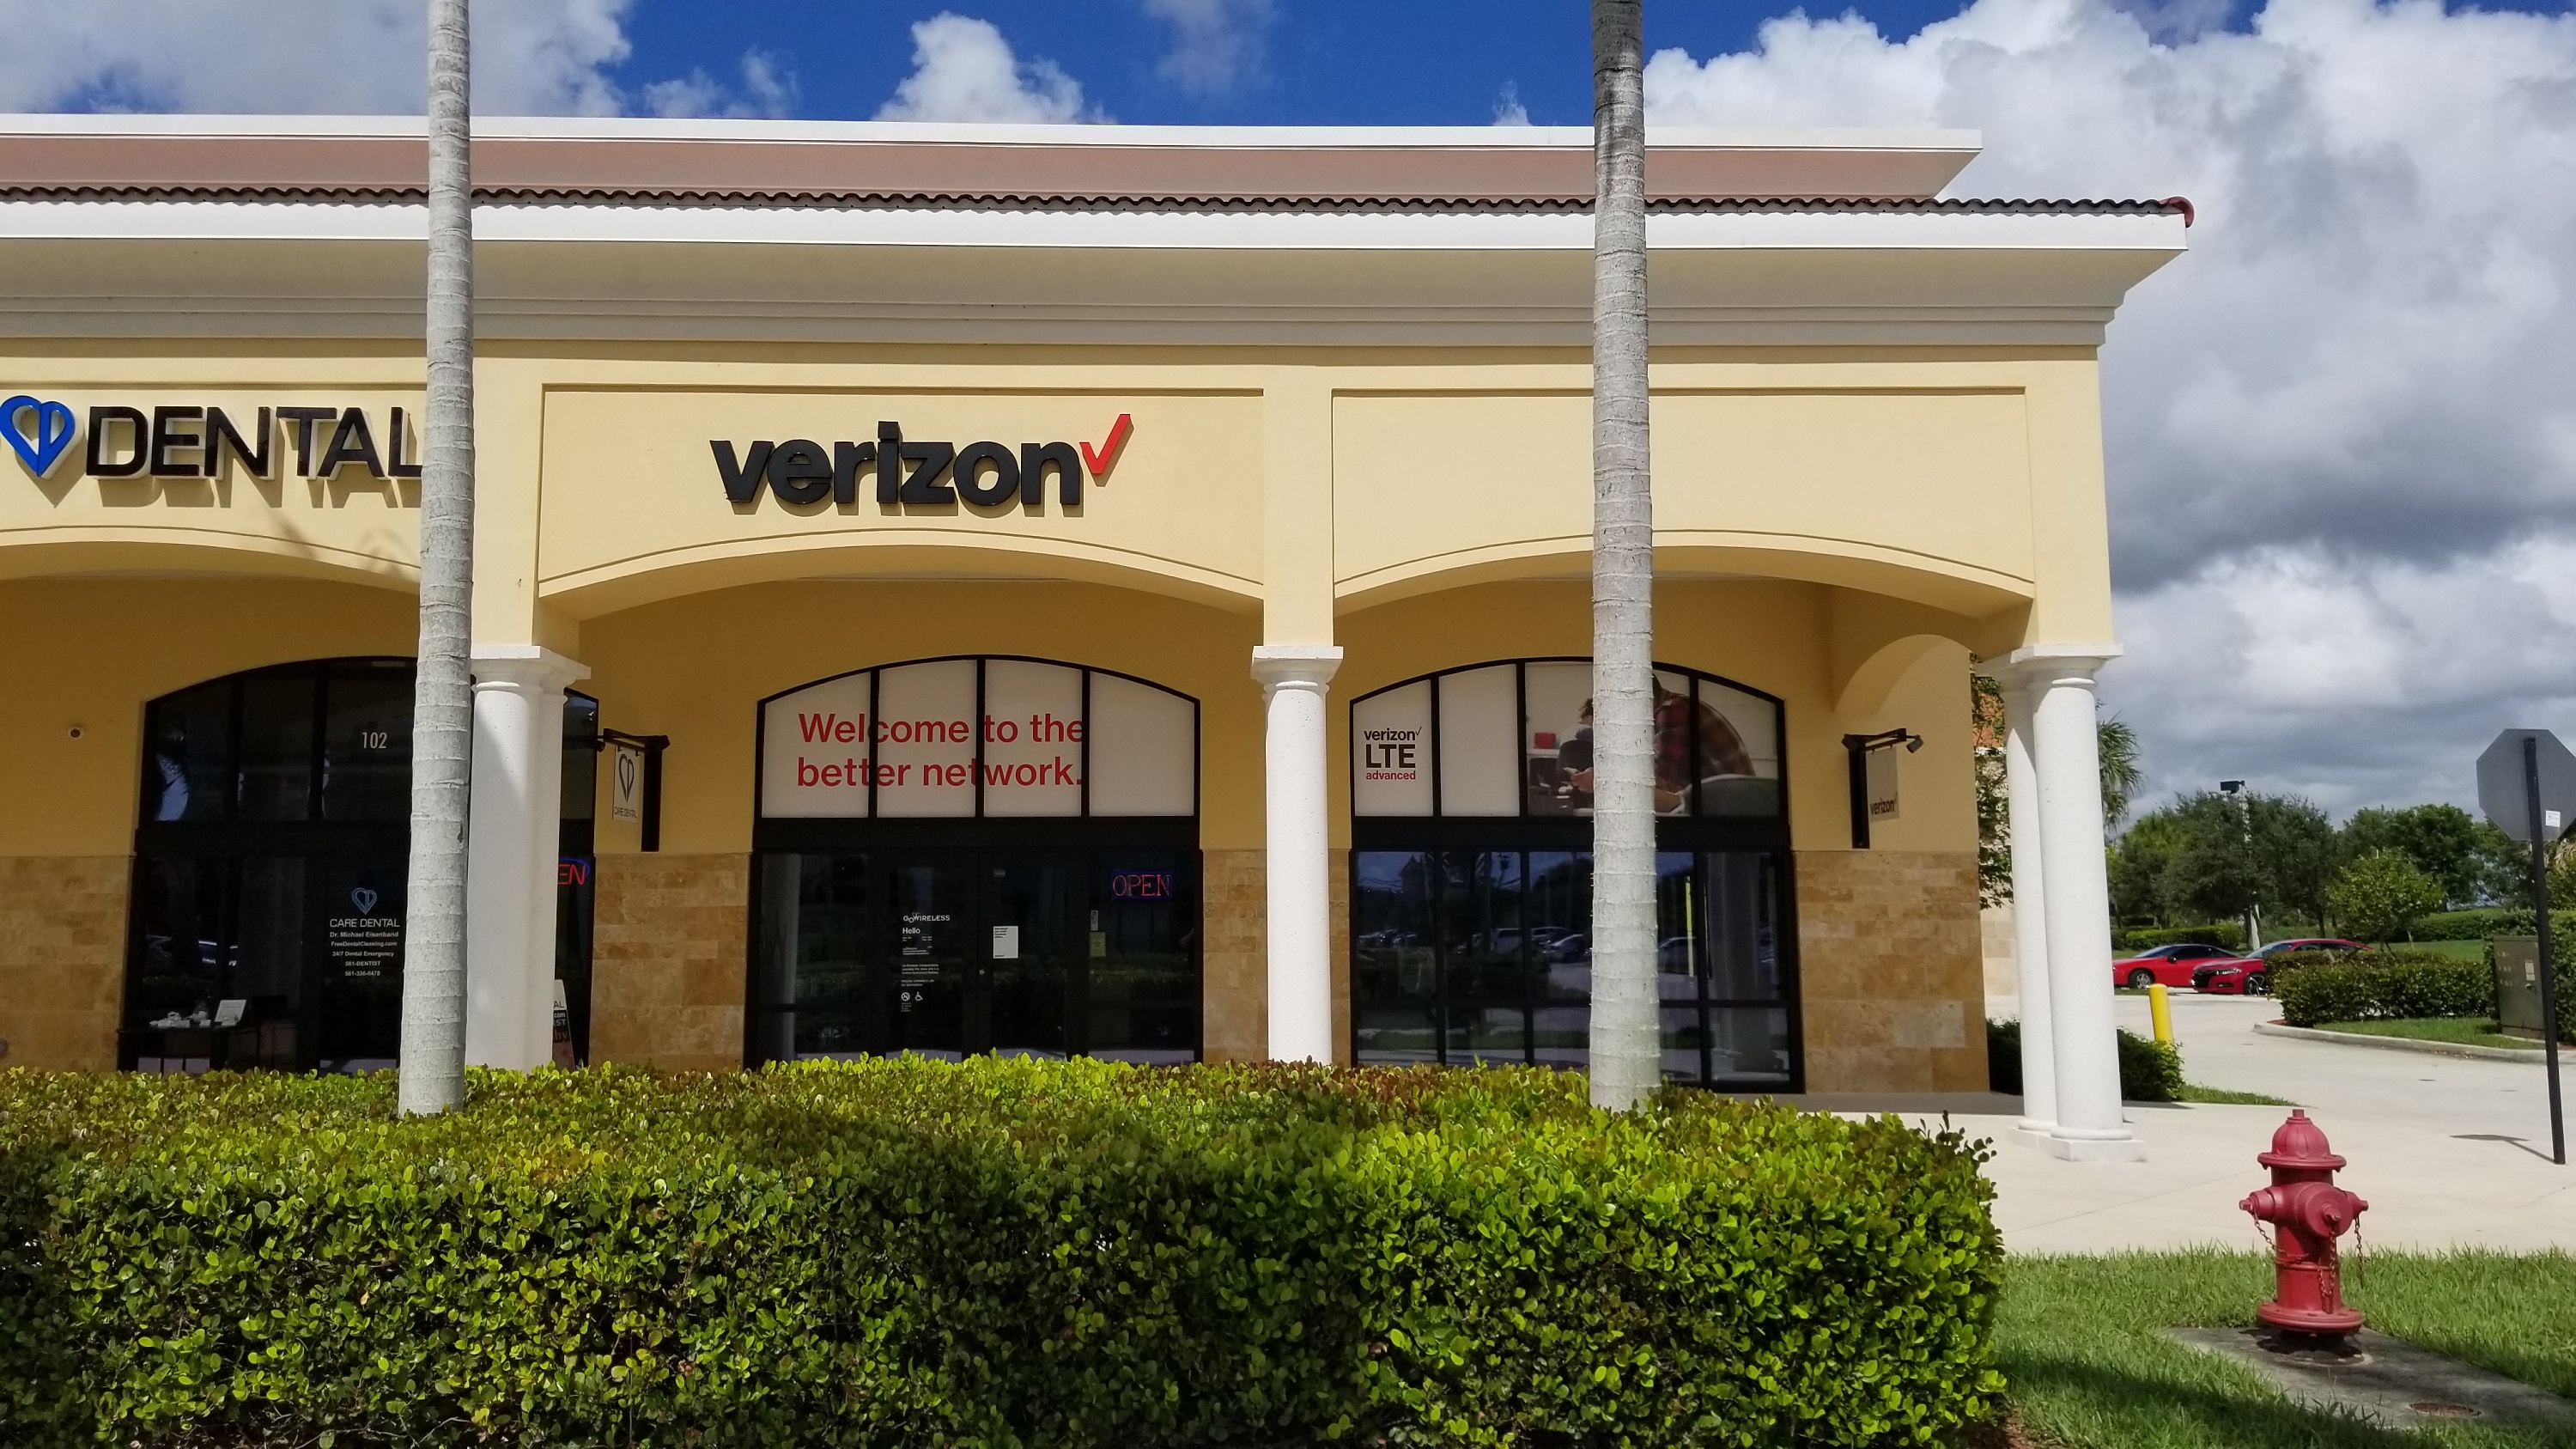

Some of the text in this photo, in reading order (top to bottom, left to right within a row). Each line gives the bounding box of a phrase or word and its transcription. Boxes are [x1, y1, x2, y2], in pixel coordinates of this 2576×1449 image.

[86, 406, 422, 478] DENTAL
[709, 421, 1081, 506] verizon
[799, 713, 1082, 743] Welcome to the
[1364, 728, 1416, 740] verizon
[362, 732, 387, 749] 102
[1366, 744, 1416, 768] LTE
[798, 756, 1082, 787] better network.
[1366, 770, 1416, 780] advanced
[1113, 874, 1171, 897] OPEN
[330, 918, 400, 928] CARE DENTAL
